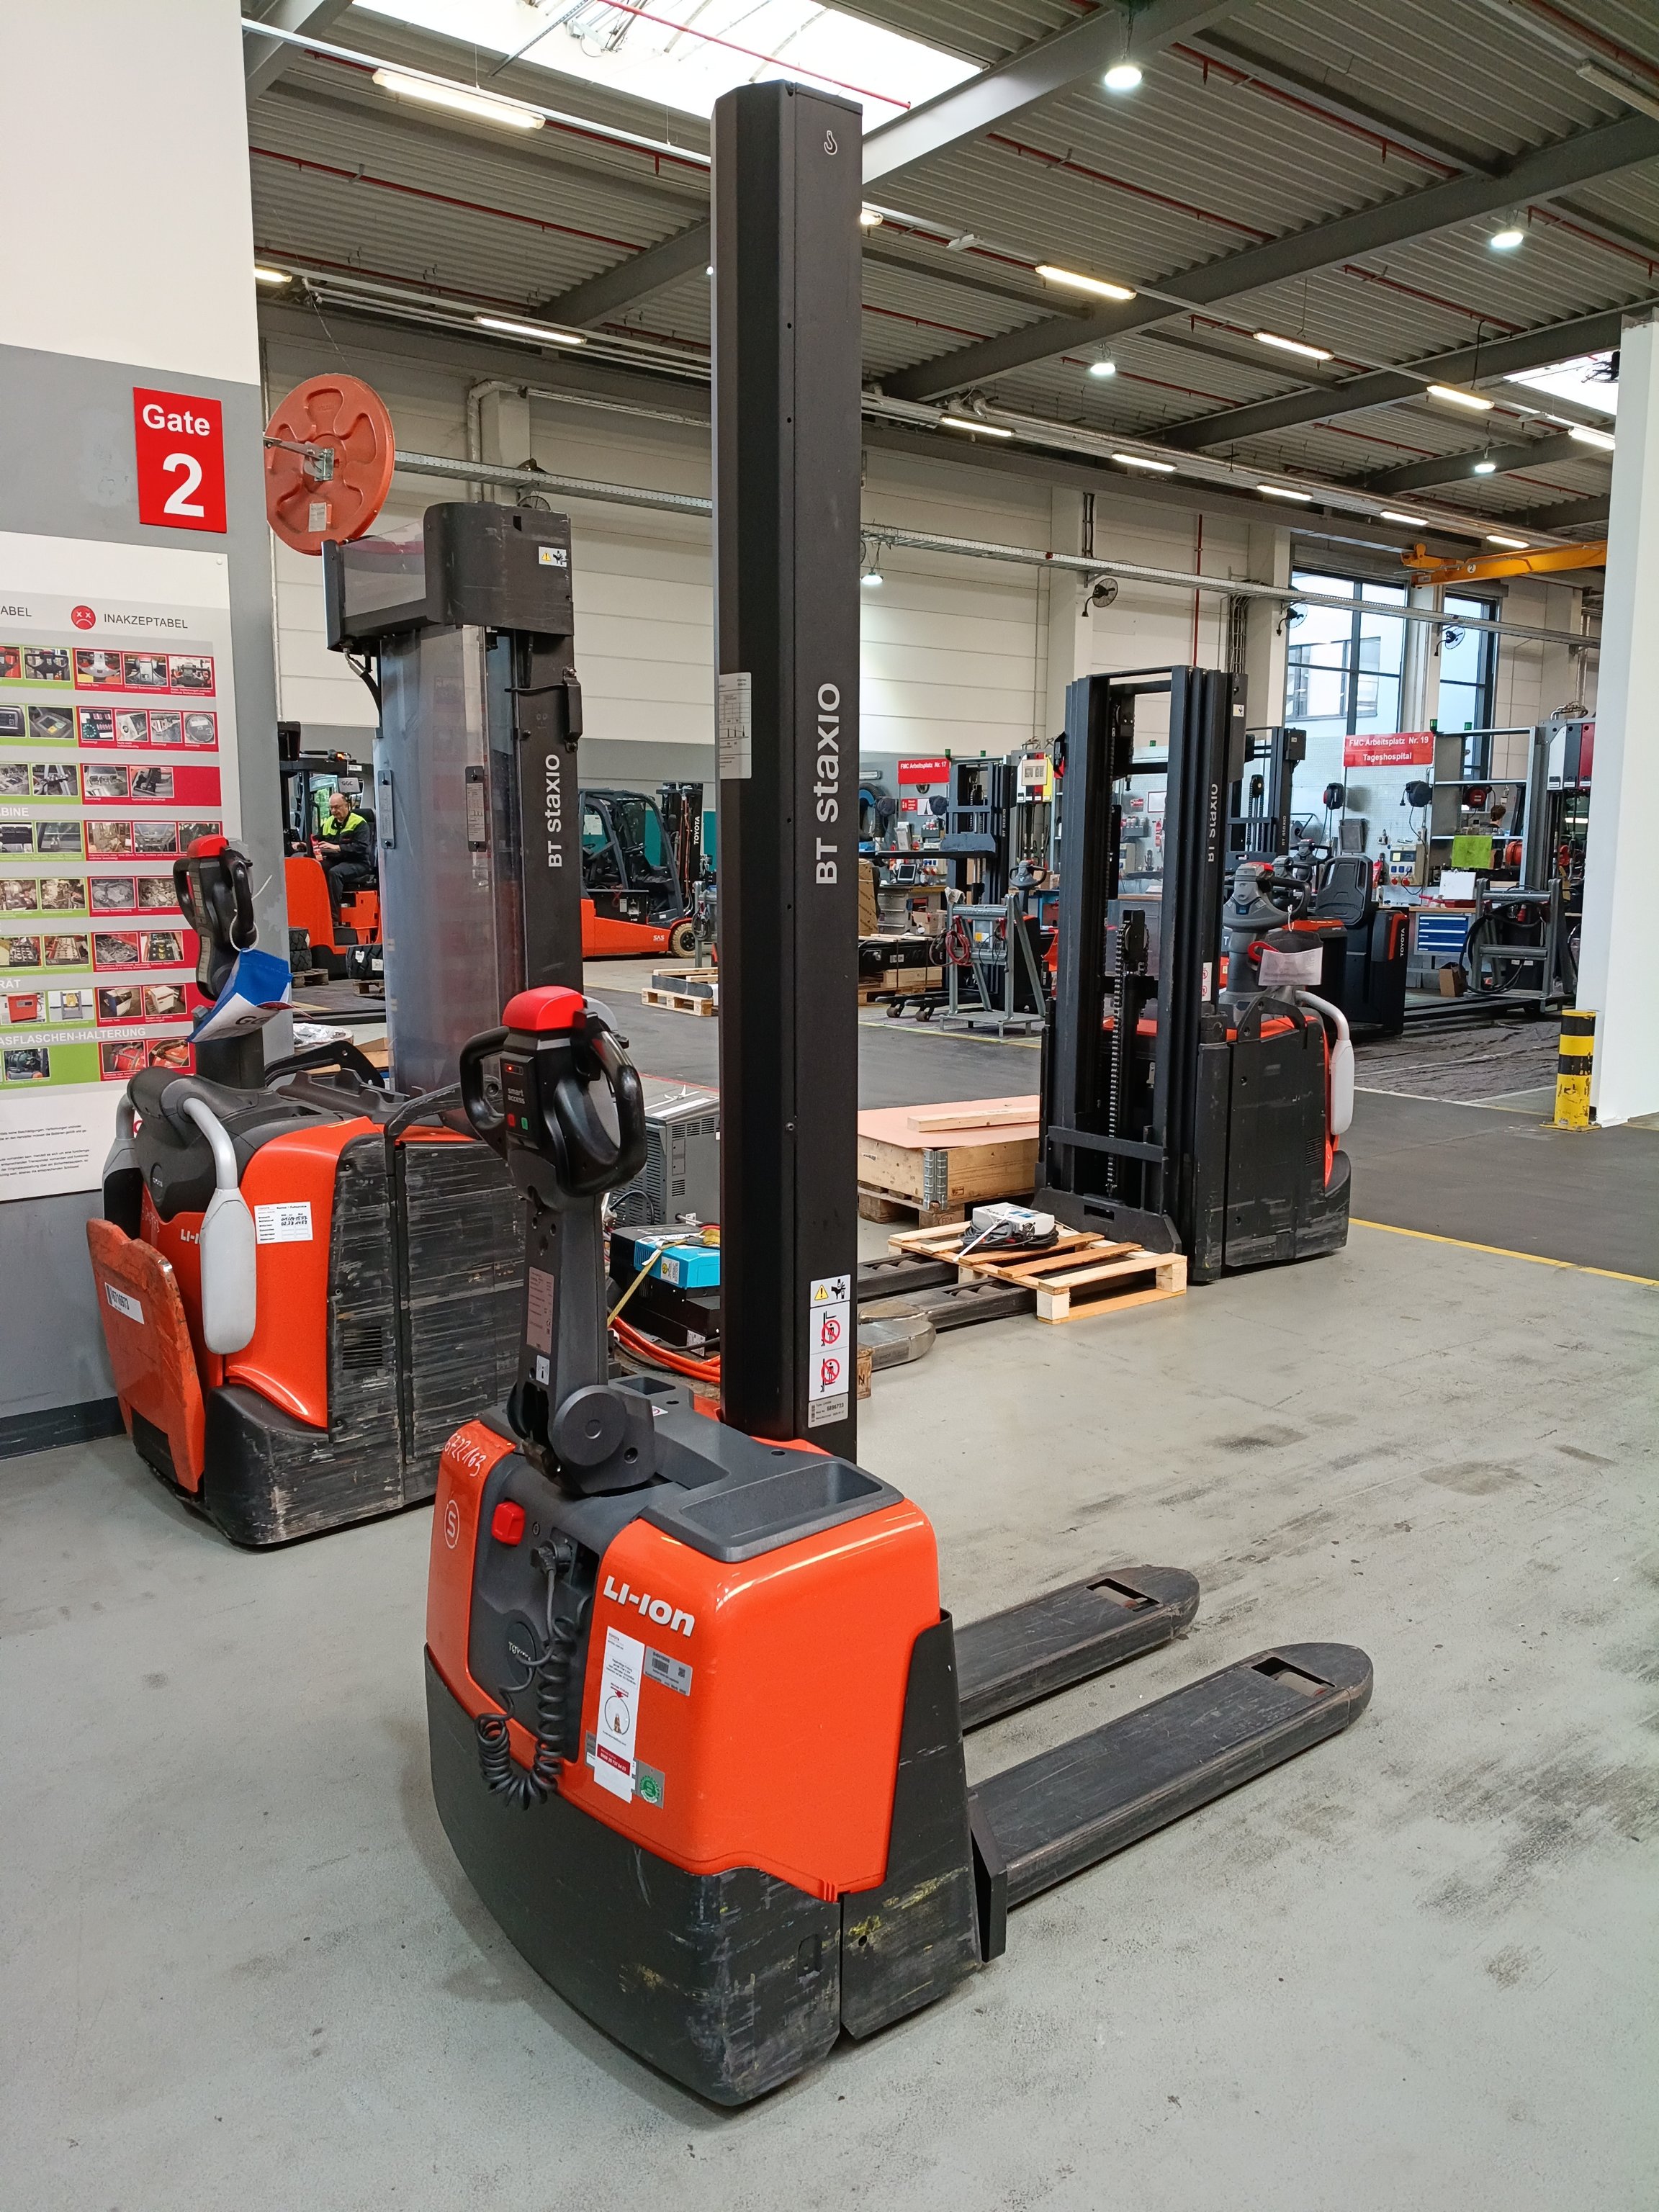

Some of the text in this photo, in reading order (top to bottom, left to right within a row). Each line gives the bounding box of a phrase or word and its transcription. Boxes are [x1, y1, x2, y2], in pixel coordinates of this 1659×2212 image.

[143, 404, 210, 436] Gate
[163, 452, 204, 518] 2
[104, 613, 188, 629] INAKZEPTABEL
[1365, 738, 1406, 747] Arbeitsplatz
[1363, 752, 1412, 763] Tageshospital
[909, 762, 933, 770] Arbeitsplatz
[0, 807, 29, 817] BINE
[549, 840, 562, 867] BT
[816, 837, 837, 884] BT
[508, 1088, 523, 1097] smart
[508, 1094, 525, 1105] access
